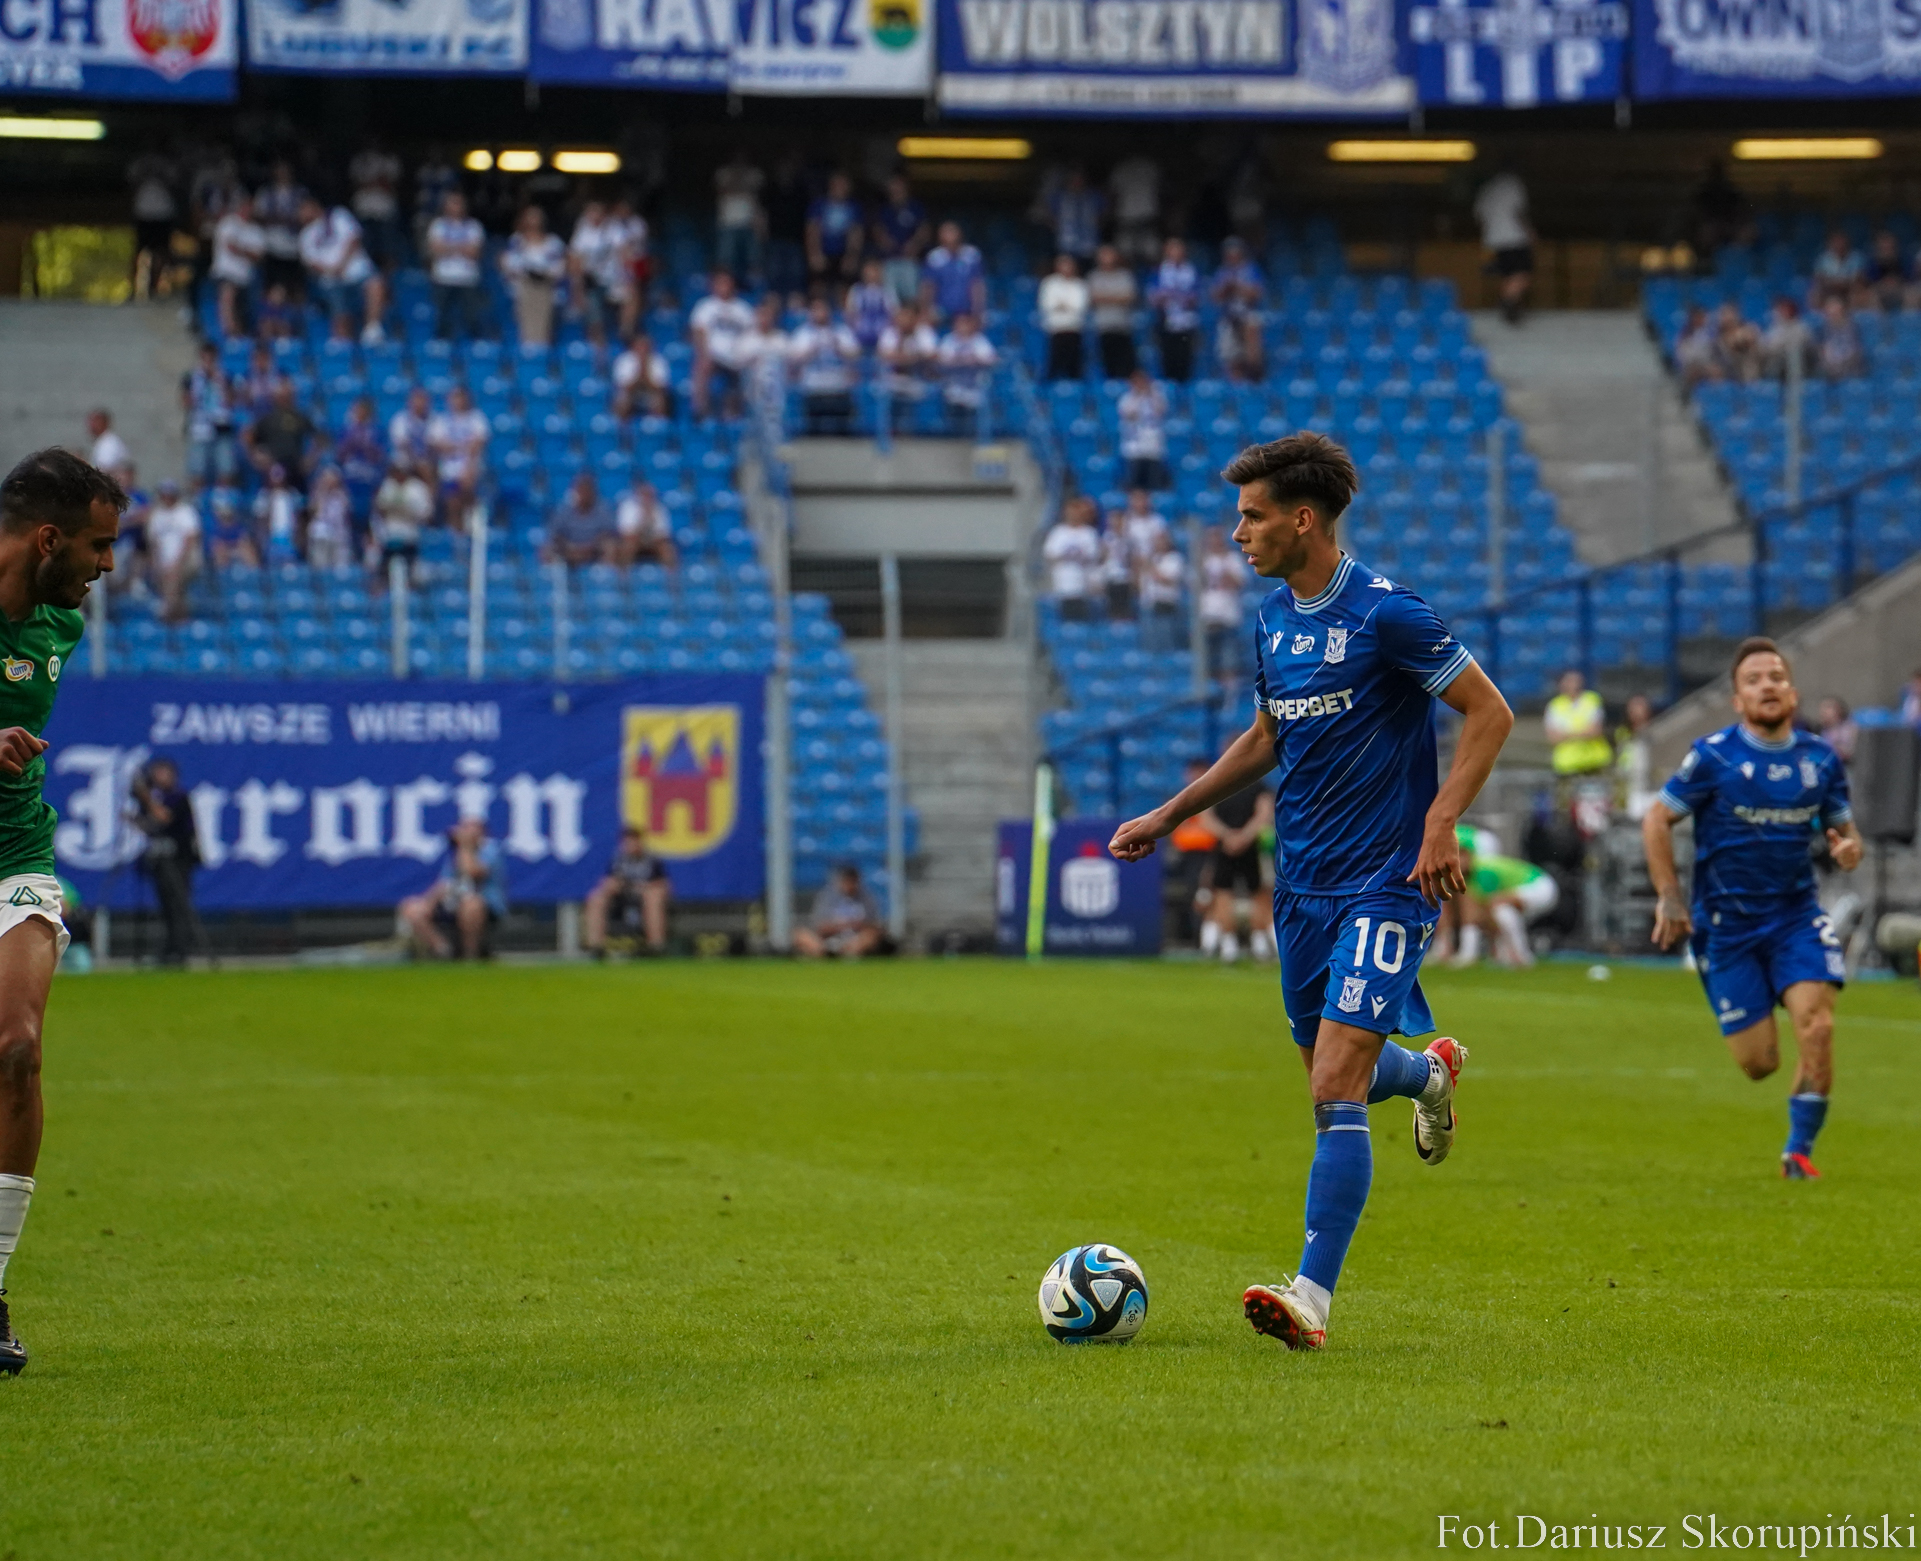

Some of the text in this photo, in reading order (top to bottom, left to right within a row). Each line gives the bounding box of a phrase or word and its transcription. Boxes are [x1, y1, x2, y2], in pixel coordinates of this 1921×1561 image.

[962, 0, 1286, 66] WOLSZTYN
[151, 702, 501, 744] ZAWSZE WIERNI
[1267, 688, 1353, 720] UPERBET
[1354, 917, 1407, 974] 10
[1812, 914, 1840, 946] 2
